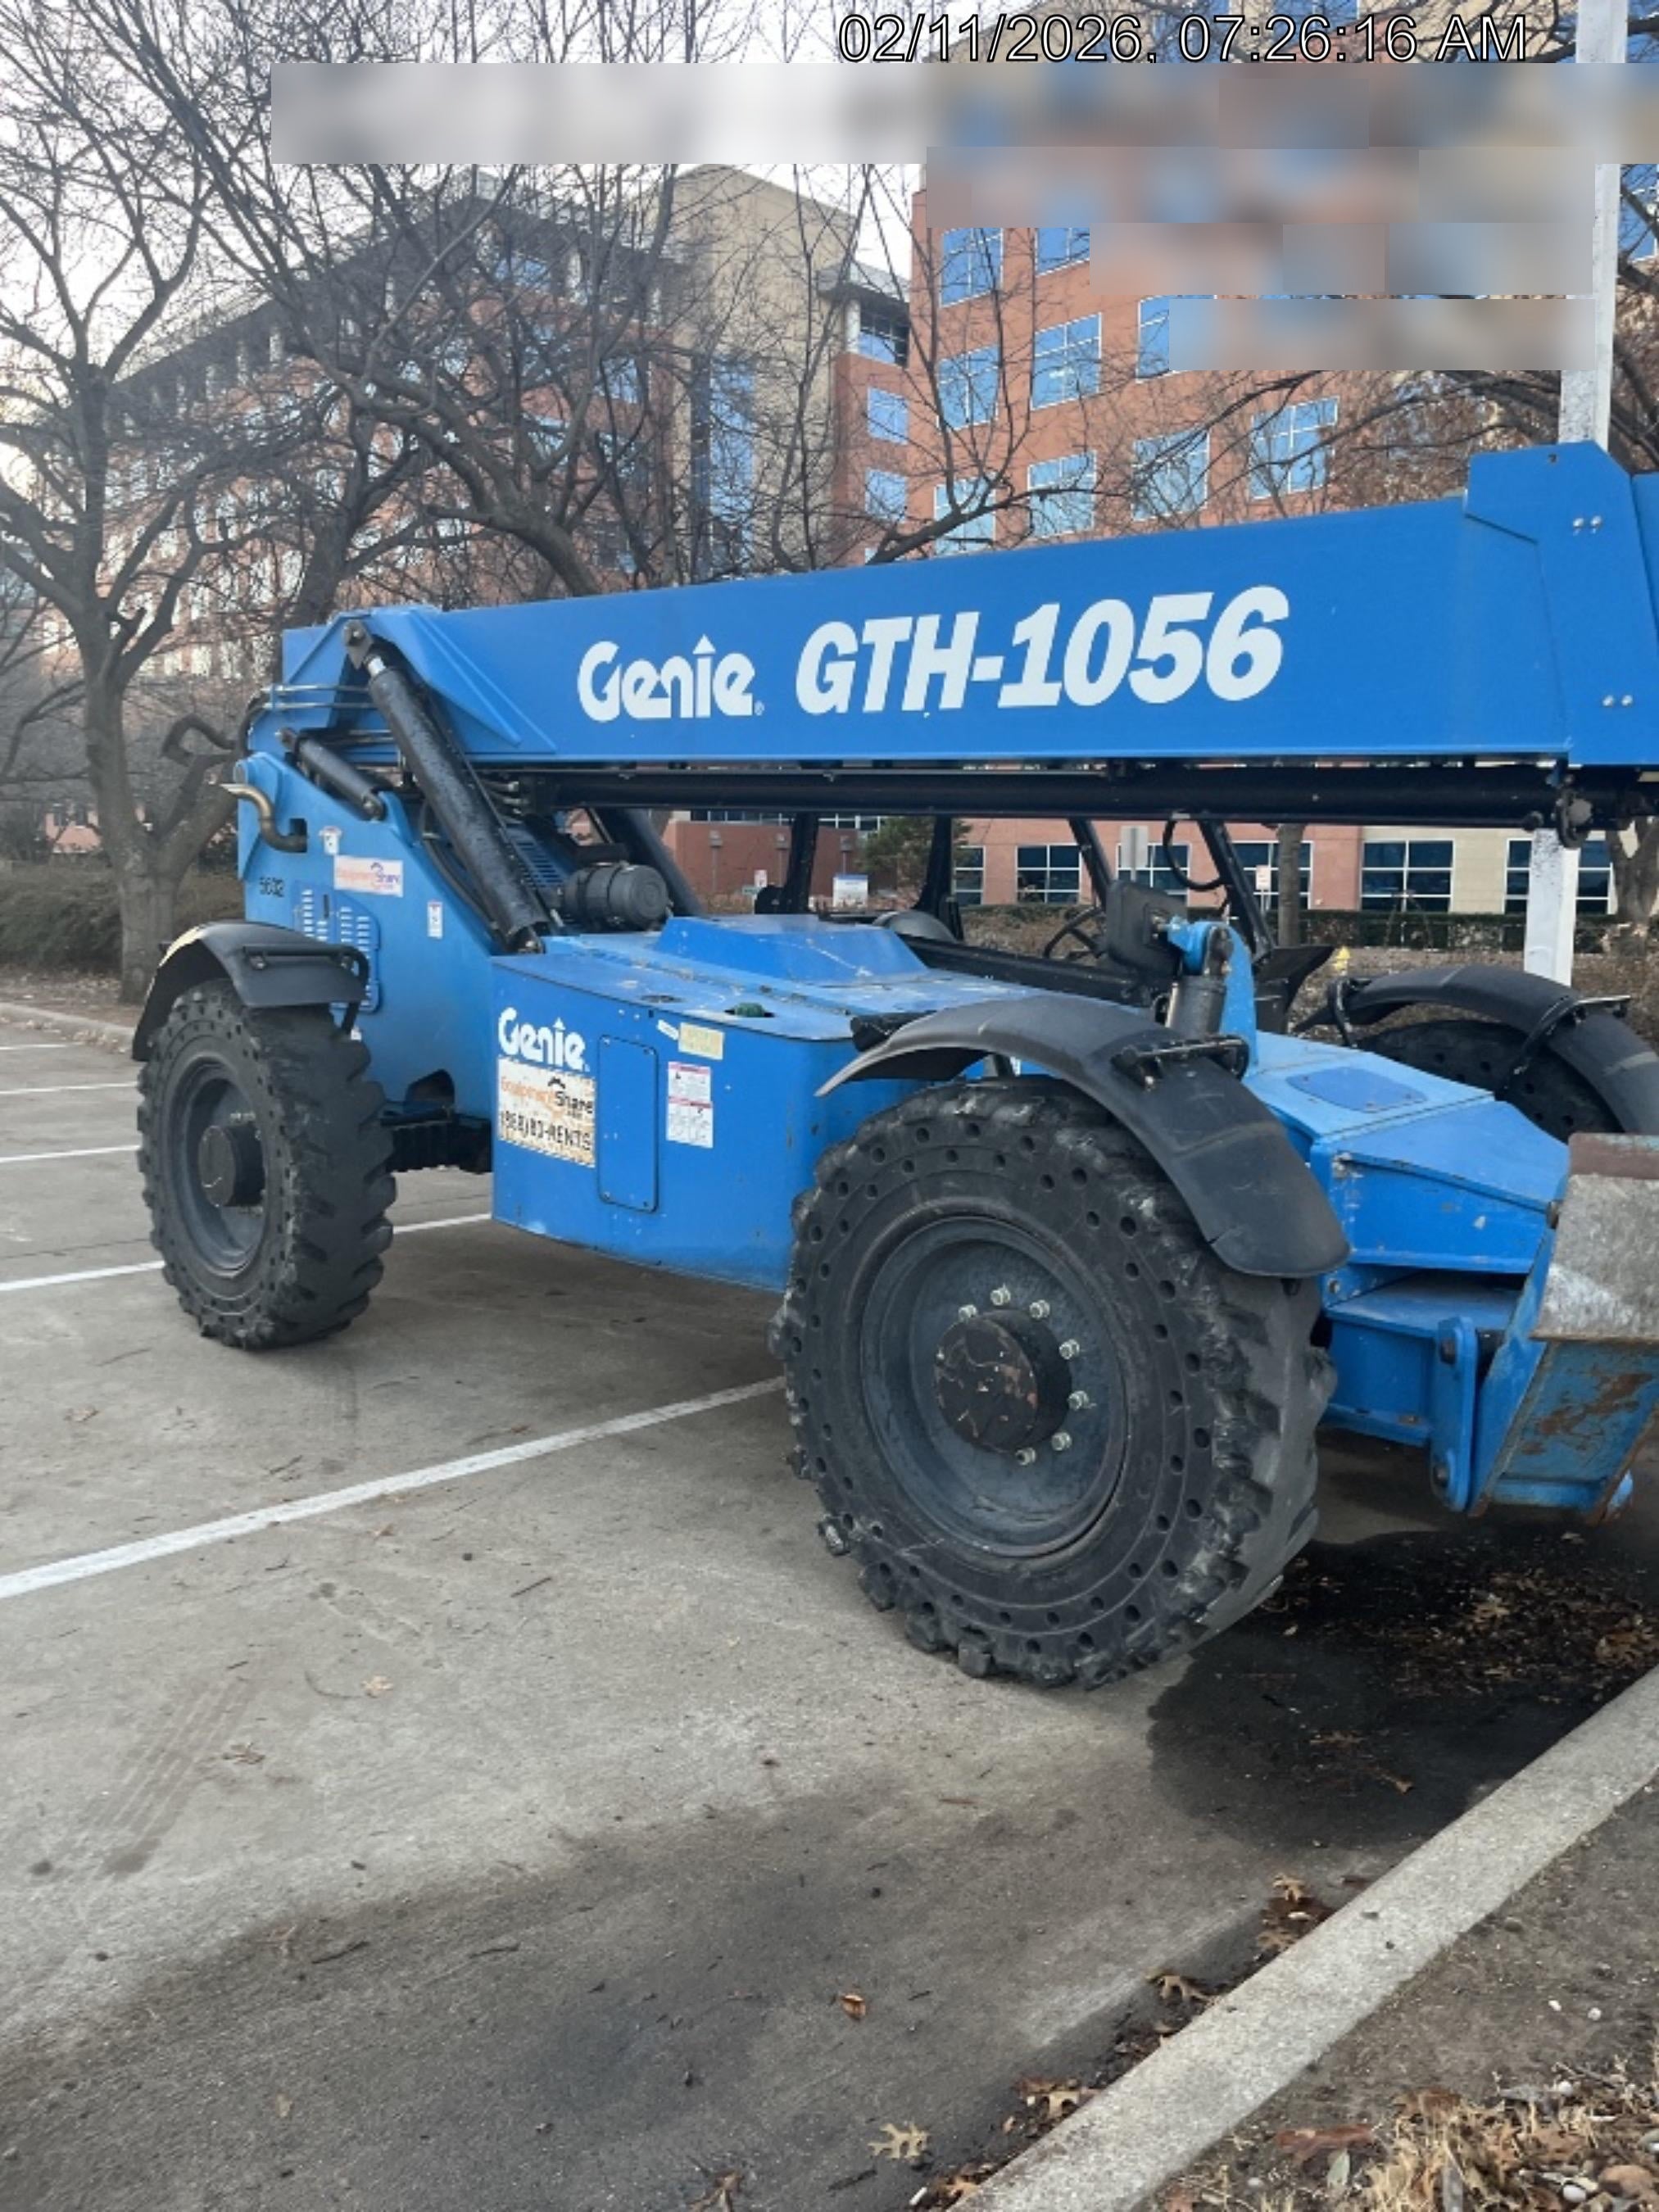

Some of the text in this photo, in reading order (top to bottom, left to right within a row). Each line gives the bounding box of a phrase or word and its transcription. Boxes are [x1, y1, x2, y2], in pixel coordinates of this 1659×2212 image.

[578, 585, 1290, 723] Genie GTH-1056
[498, 1007, 587, 1072] Genie
